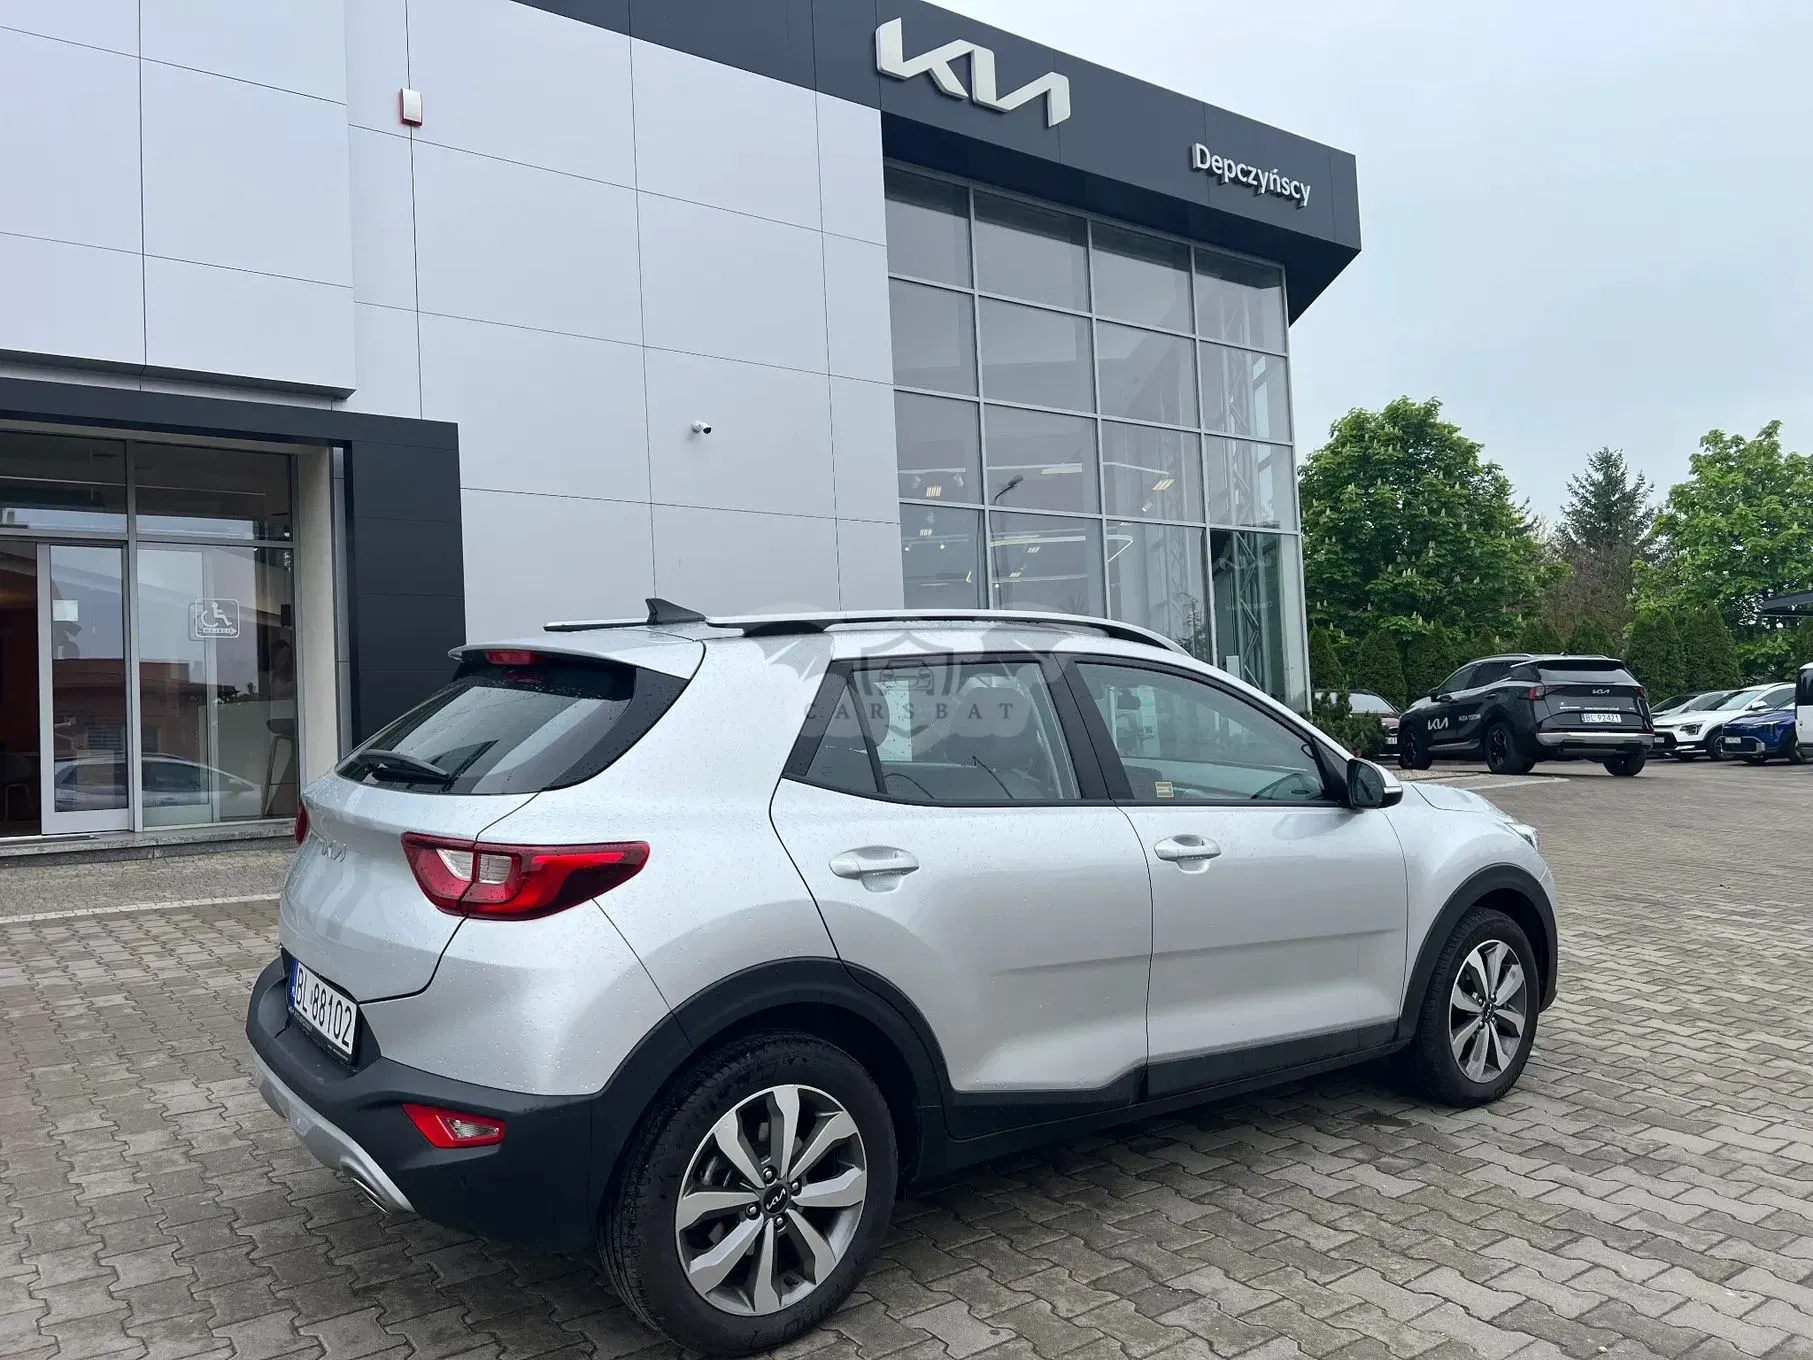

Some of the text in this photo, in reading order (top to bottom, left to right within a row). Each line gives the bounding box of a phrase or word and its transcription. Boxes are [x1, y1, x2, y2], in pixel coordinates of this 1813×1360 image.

[875, 17, 1072, 128] KIA
[1192, 142, 1311, 208] Depczyńscy
[296, 967, 308, 1013] BL
[312, 983, 353, 1048] 88102
